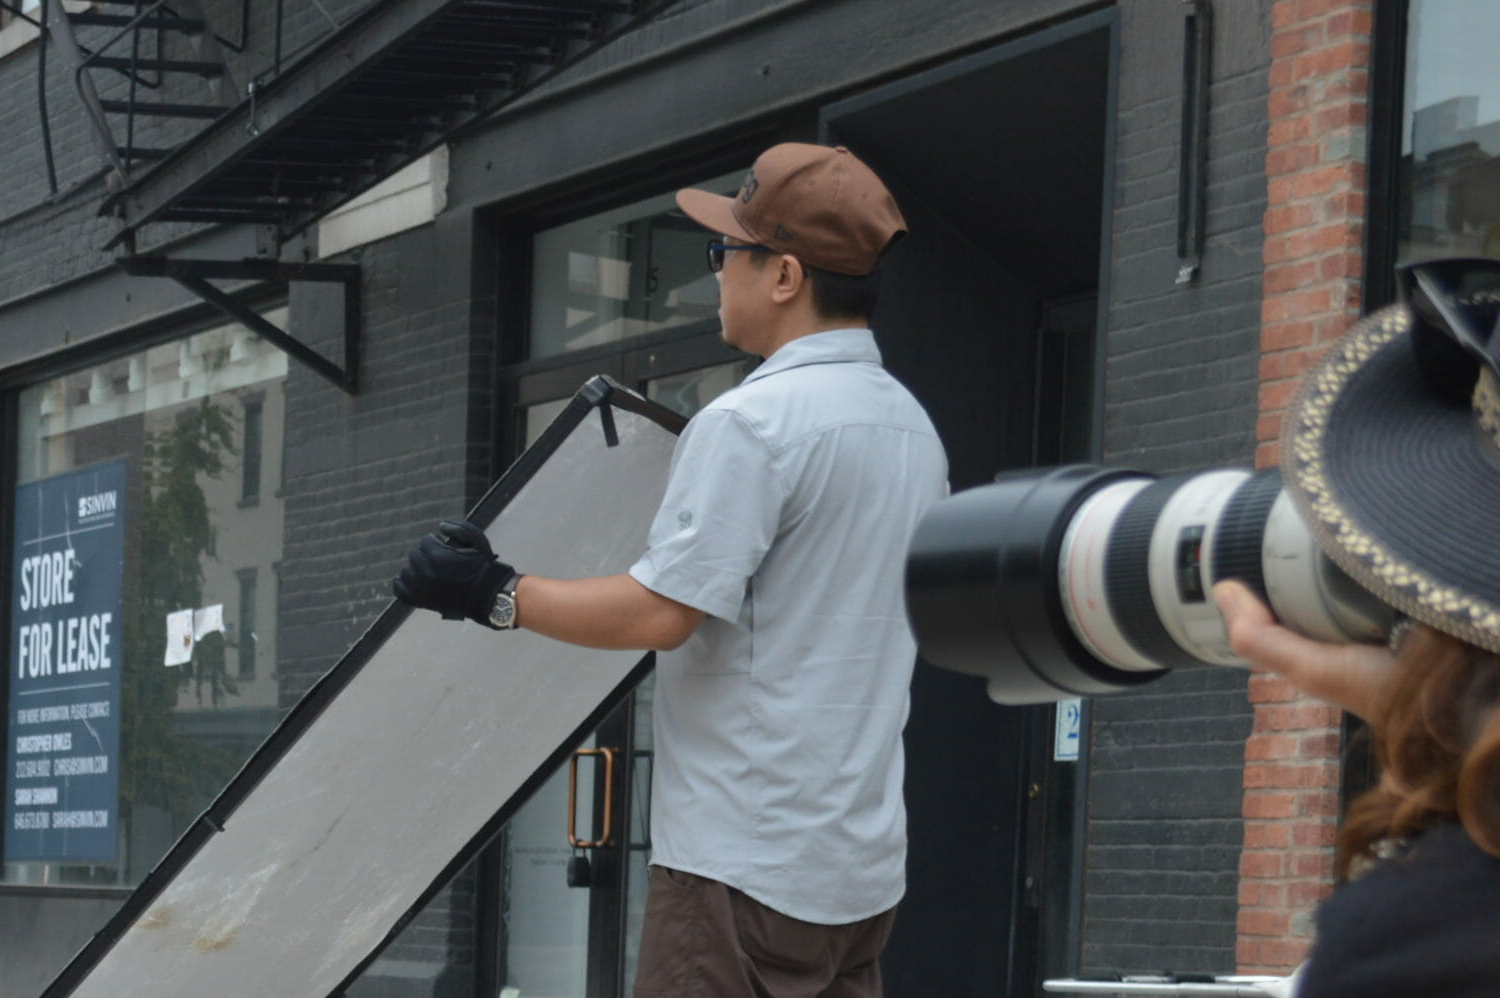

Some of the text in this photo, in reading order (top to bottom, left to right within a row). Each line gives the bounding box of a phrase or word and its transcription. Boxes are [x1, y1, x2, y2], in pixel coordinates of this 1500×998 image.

[86, 490, 117, 515] SINVIN
[20, 549, 76, 612] STORE
[18, 612, 112, 680] FOR LEASE
[71, 703, 88, 720] PLEASE
[88, 701, 110, 718] CONTACT
